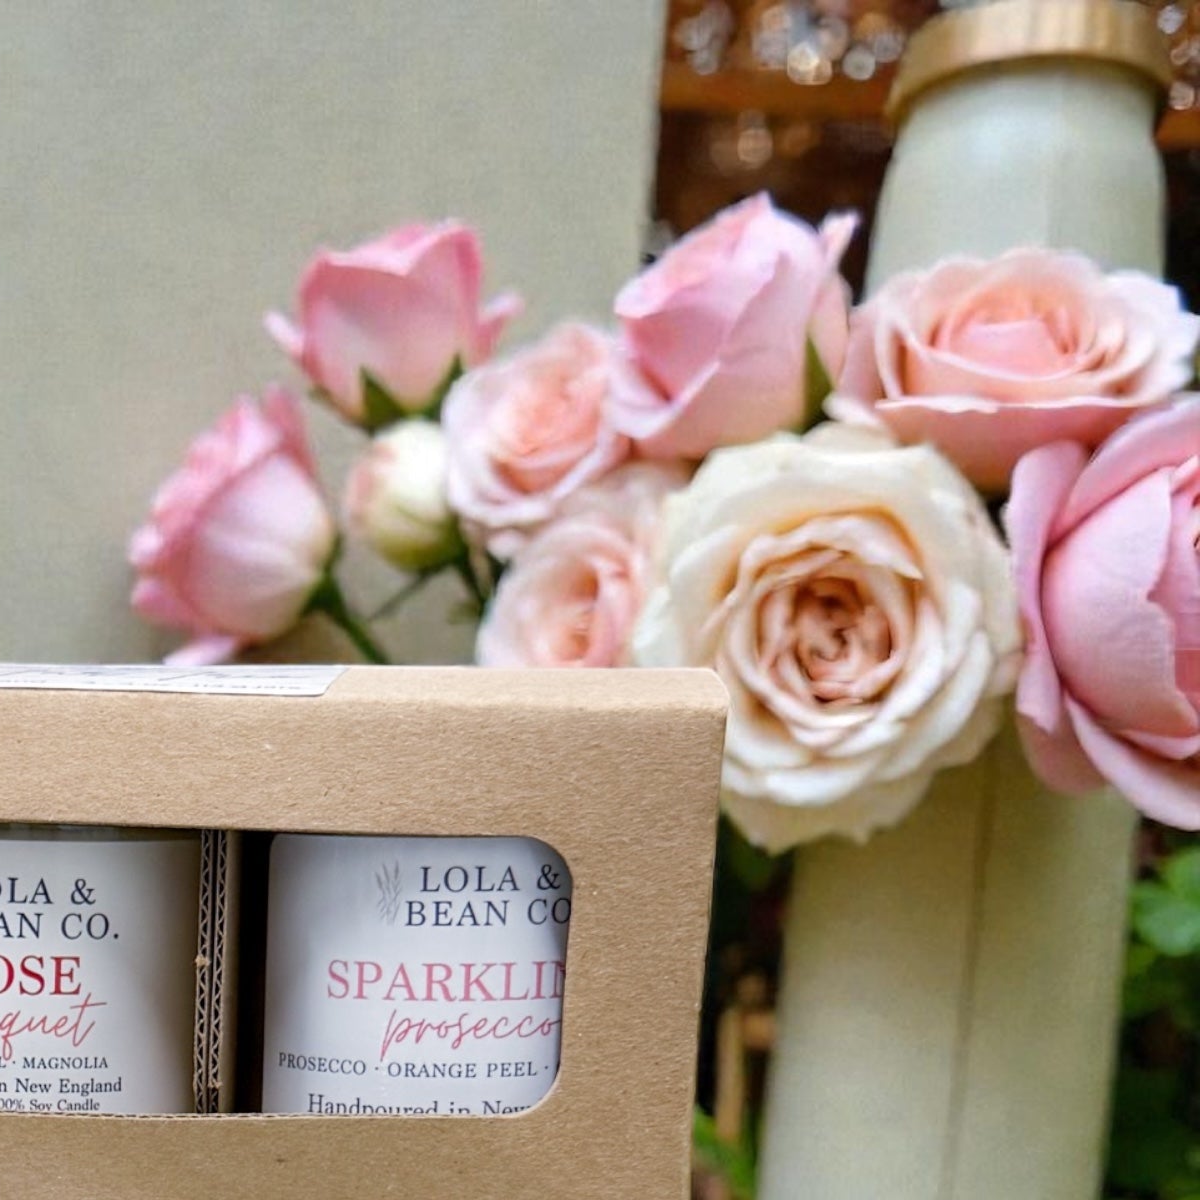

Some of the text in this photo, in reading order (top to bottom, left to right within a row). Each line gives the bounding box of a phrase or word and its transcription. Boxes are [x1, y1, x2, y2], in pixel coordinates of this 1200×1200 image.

[70, 878, 97, 905] &
[420, 864, 561, 892] LOLA &
[61, 913, 120, 940] CO.
[405, 899, 510, 927] BEAN
[380, 1009, 561, 1062] prosecco
[22, 1056, 109, 1070] MAGNOLIA
[278, 1051, 538, 1078] PROSECCO ORANGE PEEL
[15, 1077, 52, 1093] New
[59, 1077, 122, 1096] England
[57, 1098, 100, 1111] Candle
